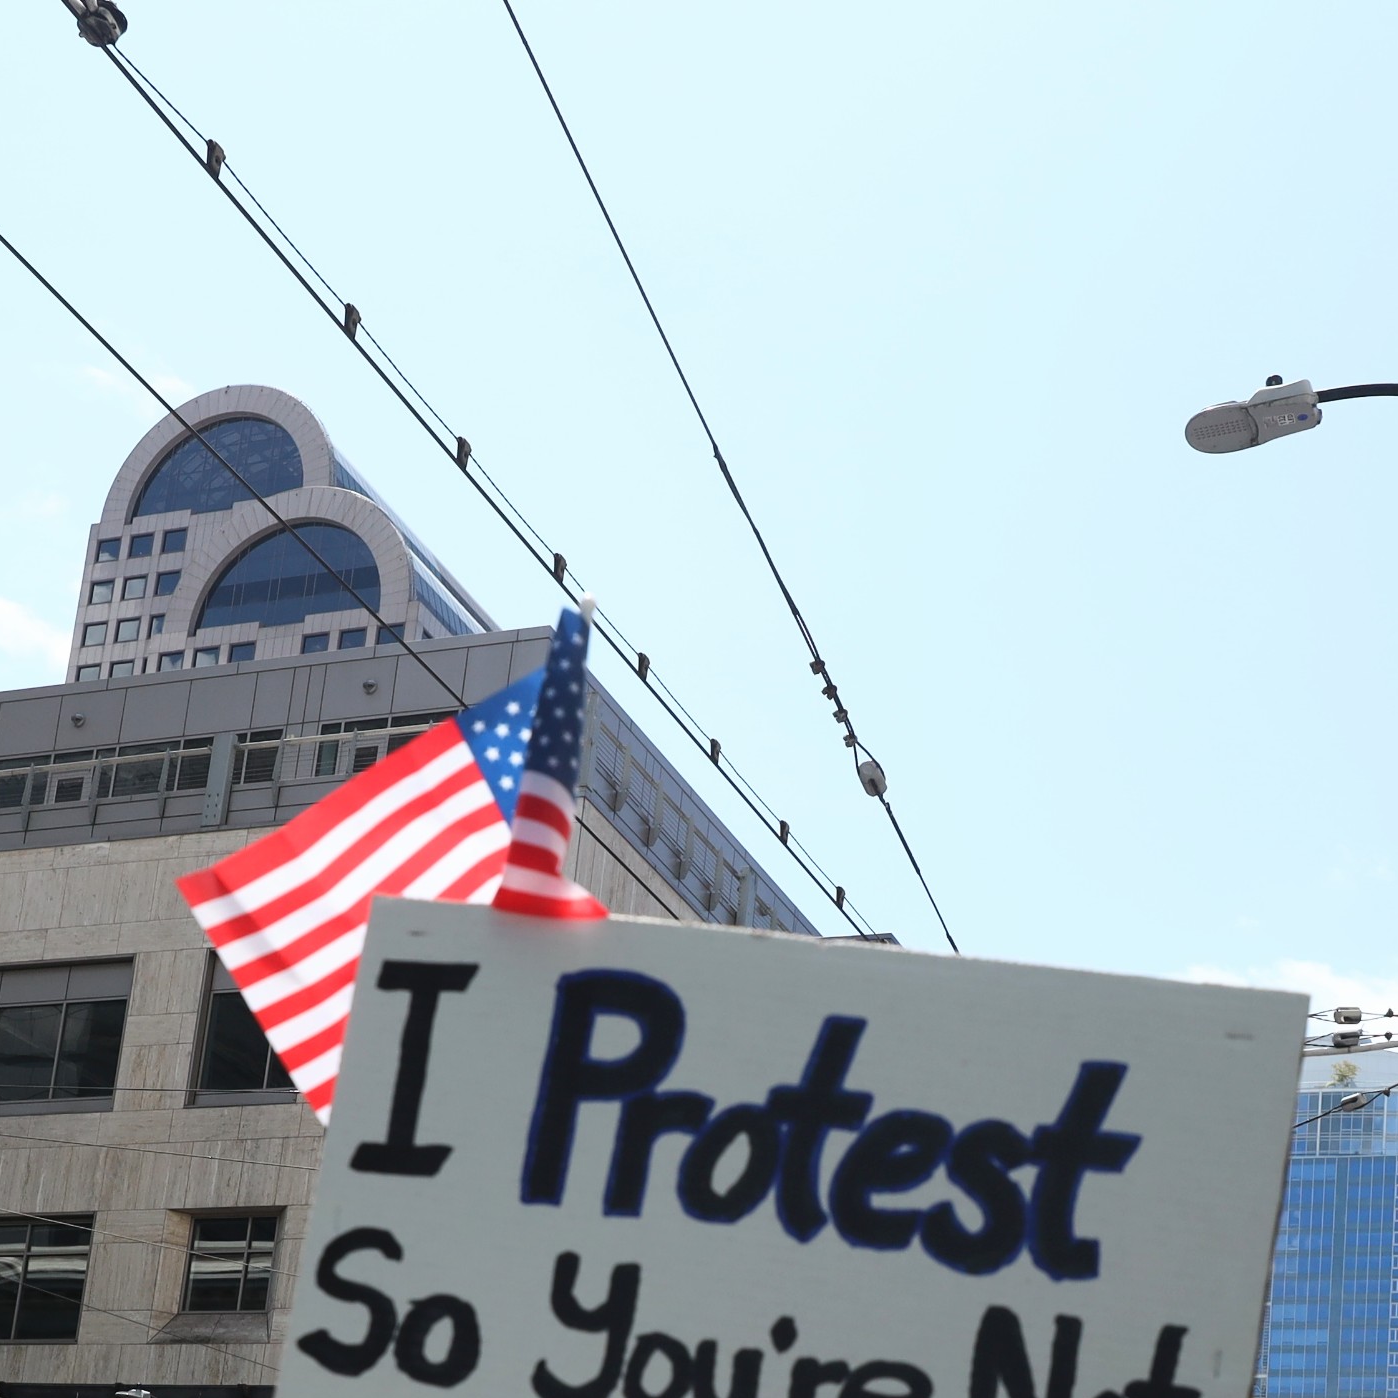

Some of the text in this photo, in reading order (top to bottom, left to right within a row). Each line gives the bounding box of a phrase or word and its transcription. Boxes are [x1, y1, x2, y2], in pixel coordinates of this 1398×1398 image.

[349, 960, 1143, 1282] I Protest
[297, 1227, 481, 1388] So
